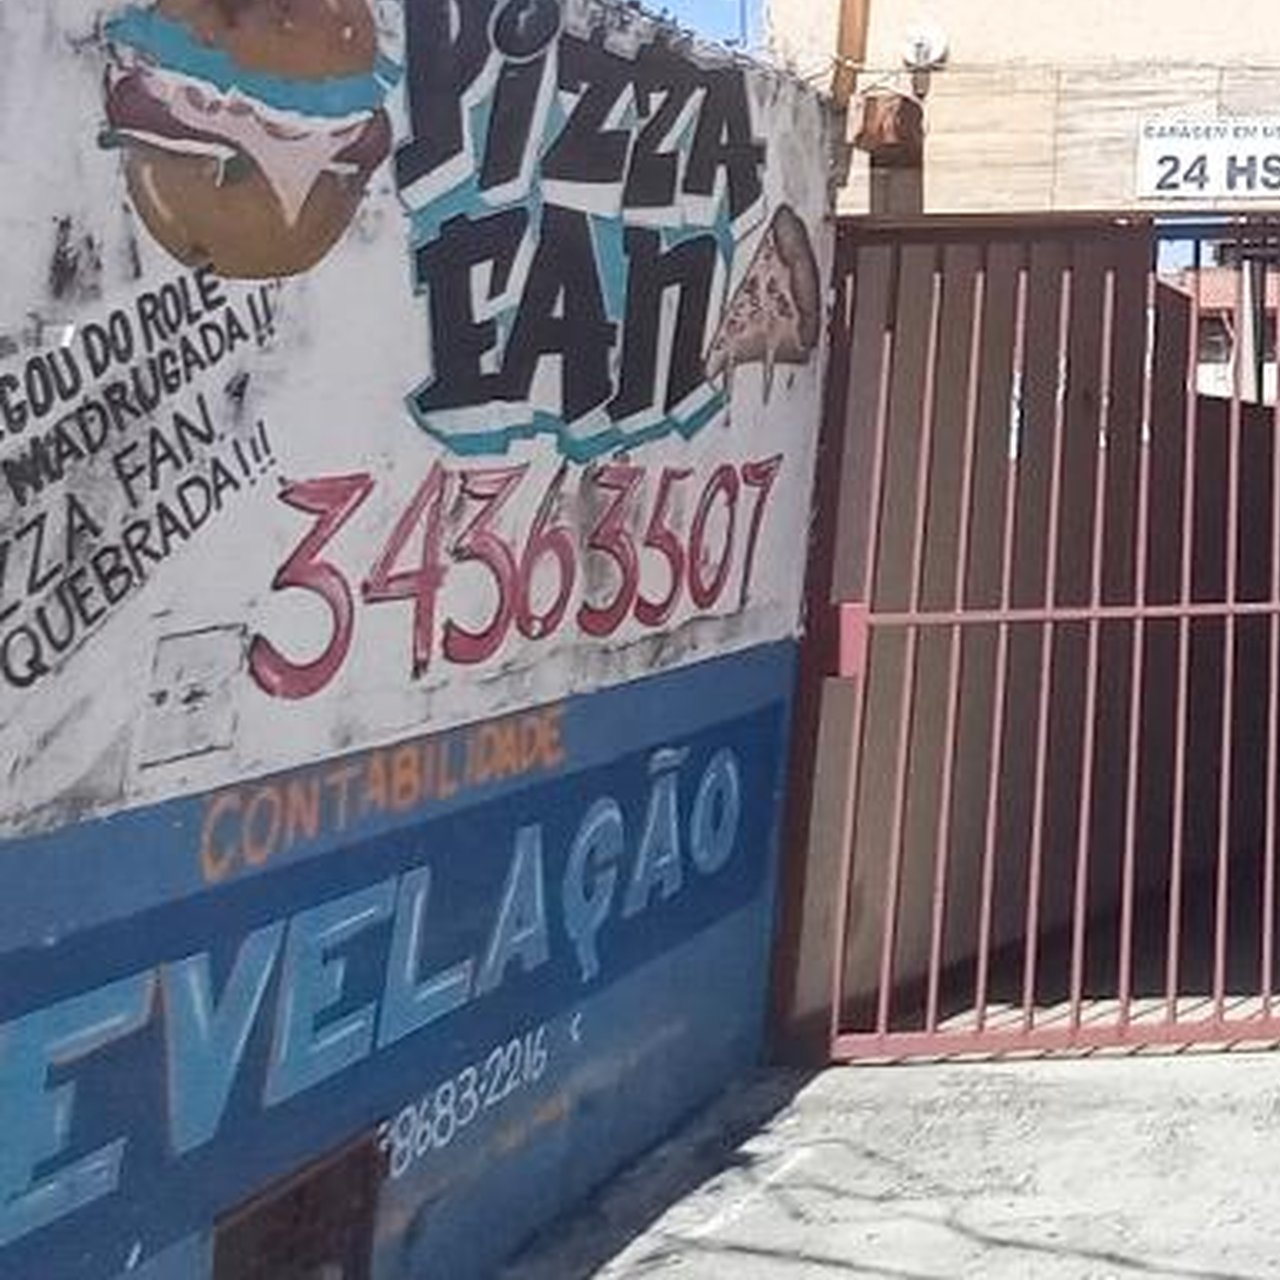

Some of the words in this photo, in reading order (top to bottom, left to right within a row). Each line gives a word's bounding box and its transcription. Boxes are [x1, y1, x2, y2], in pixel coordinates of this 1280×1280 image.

[1233, 124, 1257, 139] EM
[1155, 154, 1209, 191] 24
[80, 310, 134, 380] DO
[248, 454, 784, 700] 34363507
[202, 705, 569, 882] CONTABILIDADE
